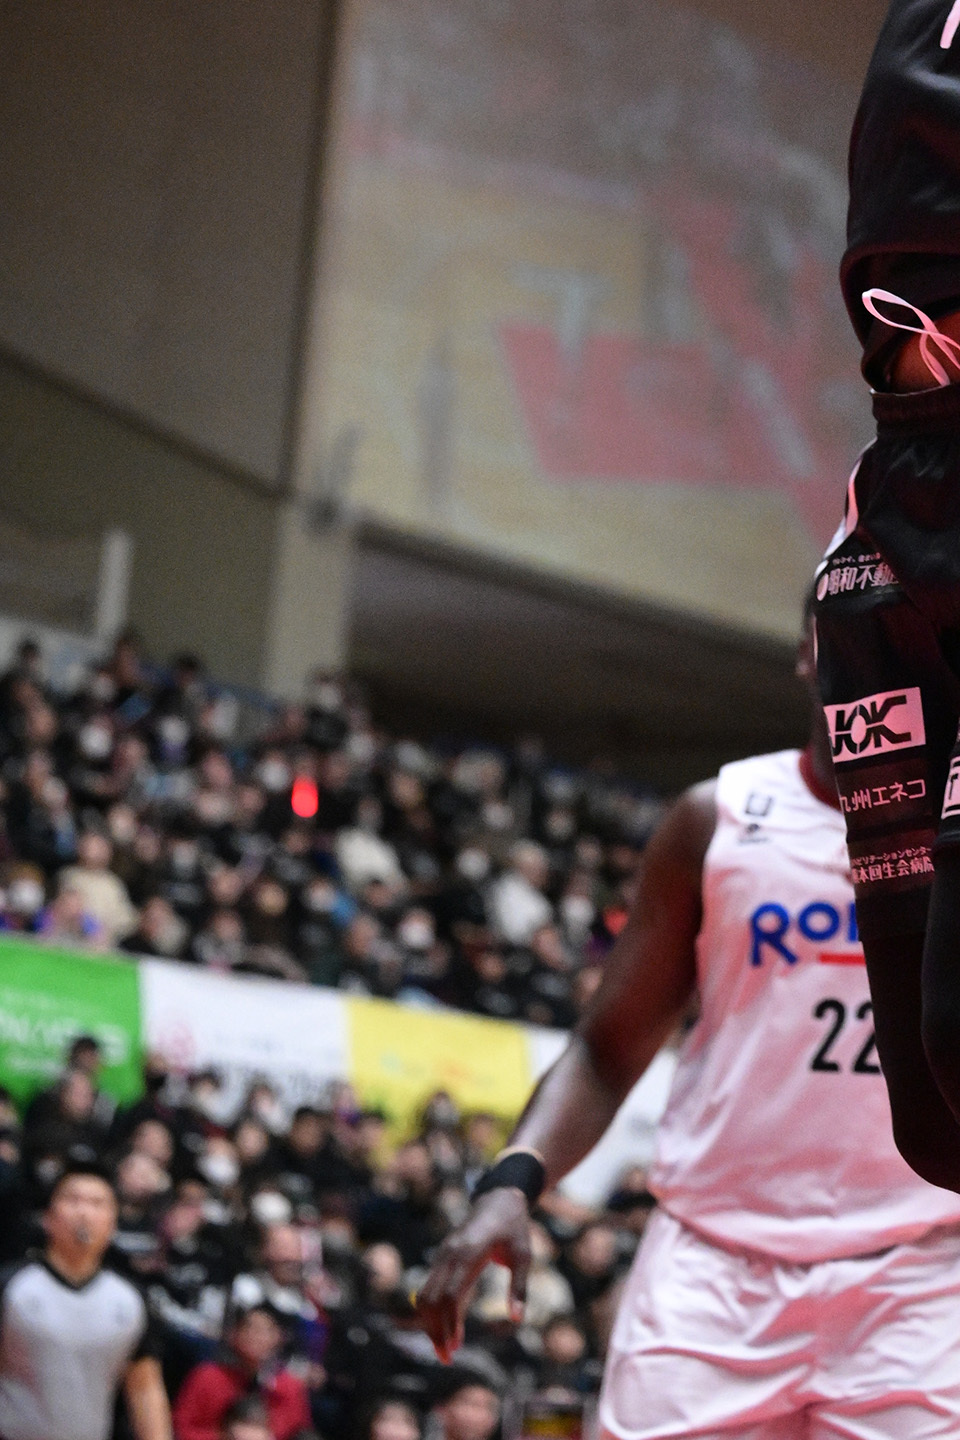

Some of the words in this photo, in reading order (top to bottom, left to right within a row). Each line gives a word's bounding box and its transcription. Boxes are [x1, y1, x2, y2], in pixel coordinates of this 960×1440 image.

[828, 562, 899, 596] 明和不動
[811, 998, 881, 1073] 22
